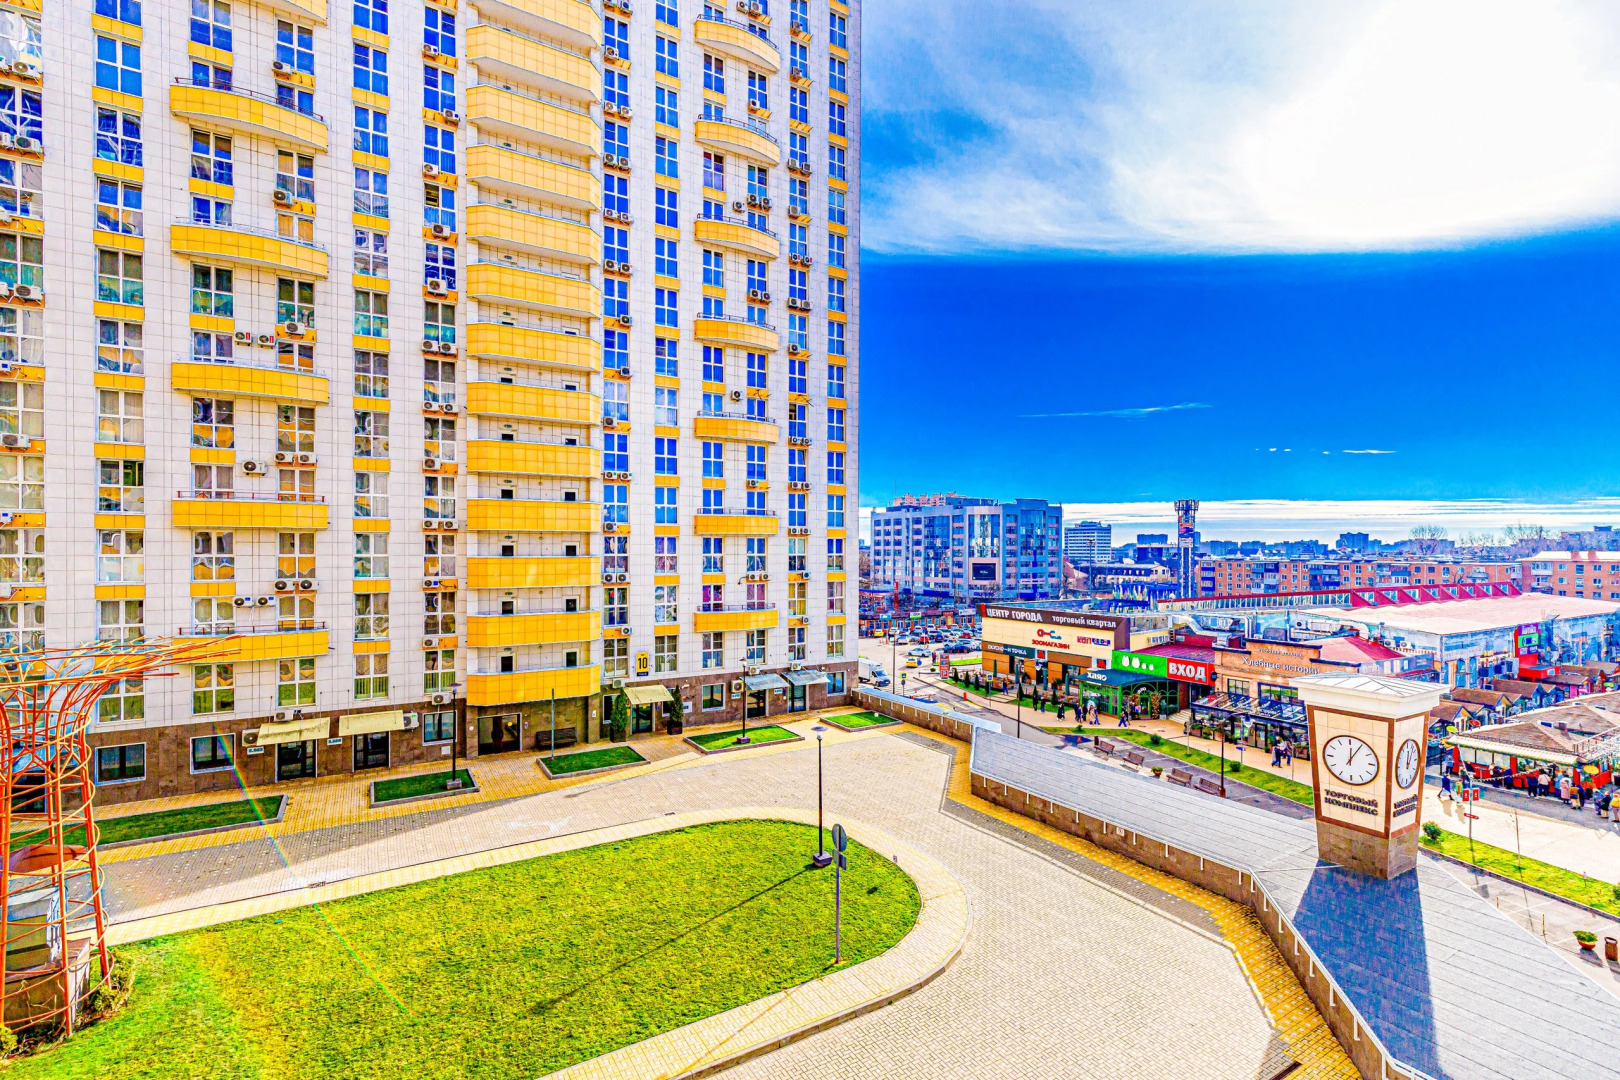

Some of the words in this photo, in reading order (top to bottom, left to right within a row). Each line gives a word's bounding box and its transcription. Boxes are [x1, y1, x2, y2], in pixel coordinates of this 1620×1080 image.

[986, 608, 1010, 618] ЦЕНТР
[1011, 611, 1043, 622] ГОРОДА
[1052, 615, 1085, 625] торговый
[1086, 619, 1117, 629] квартал
[1031, 639, 1070, 650] ЗООМАГАЗИН
[638, 657, 647, 669] 10
[1241, 655, 1281, 670] Хлебные
[1283, 664, 1320, 675] истории
[1168, 662, 1207, 682] ВХОД
[1324, 789, 1378, 808] ТОРГОВЫЙ
[1324, 797, 1378, 815] КОМПЛЕКС
